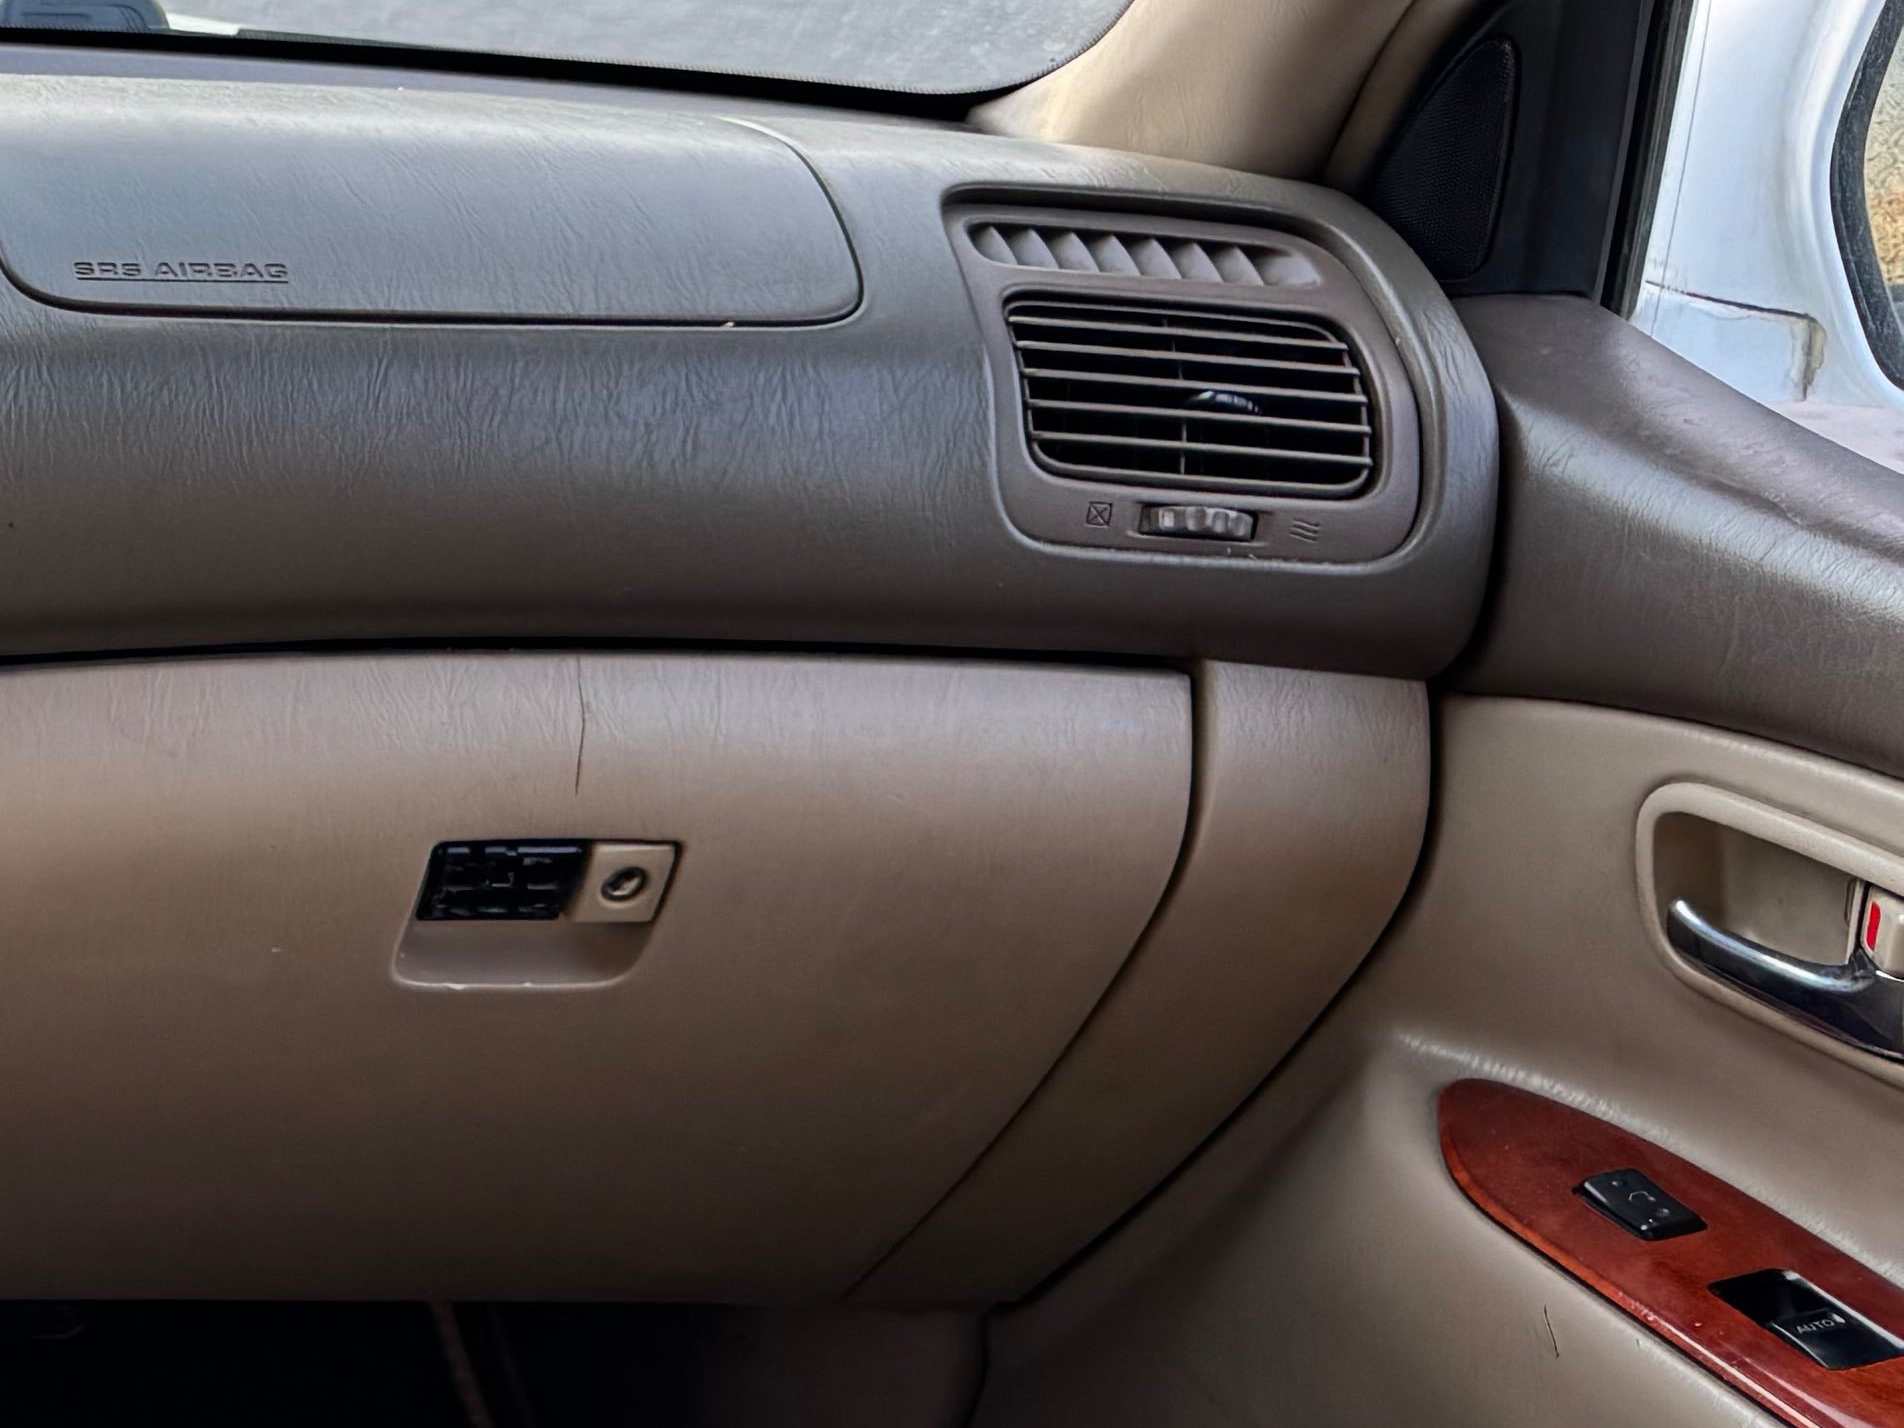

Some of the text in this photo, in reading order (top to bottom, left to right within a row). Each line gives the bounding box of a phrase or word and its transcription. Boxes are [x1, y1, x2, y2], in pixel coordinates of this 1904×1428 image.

[73, 261, 289, 278] SRS AIRBAG
[1795, 1317, 1836, 1335] AUTO
